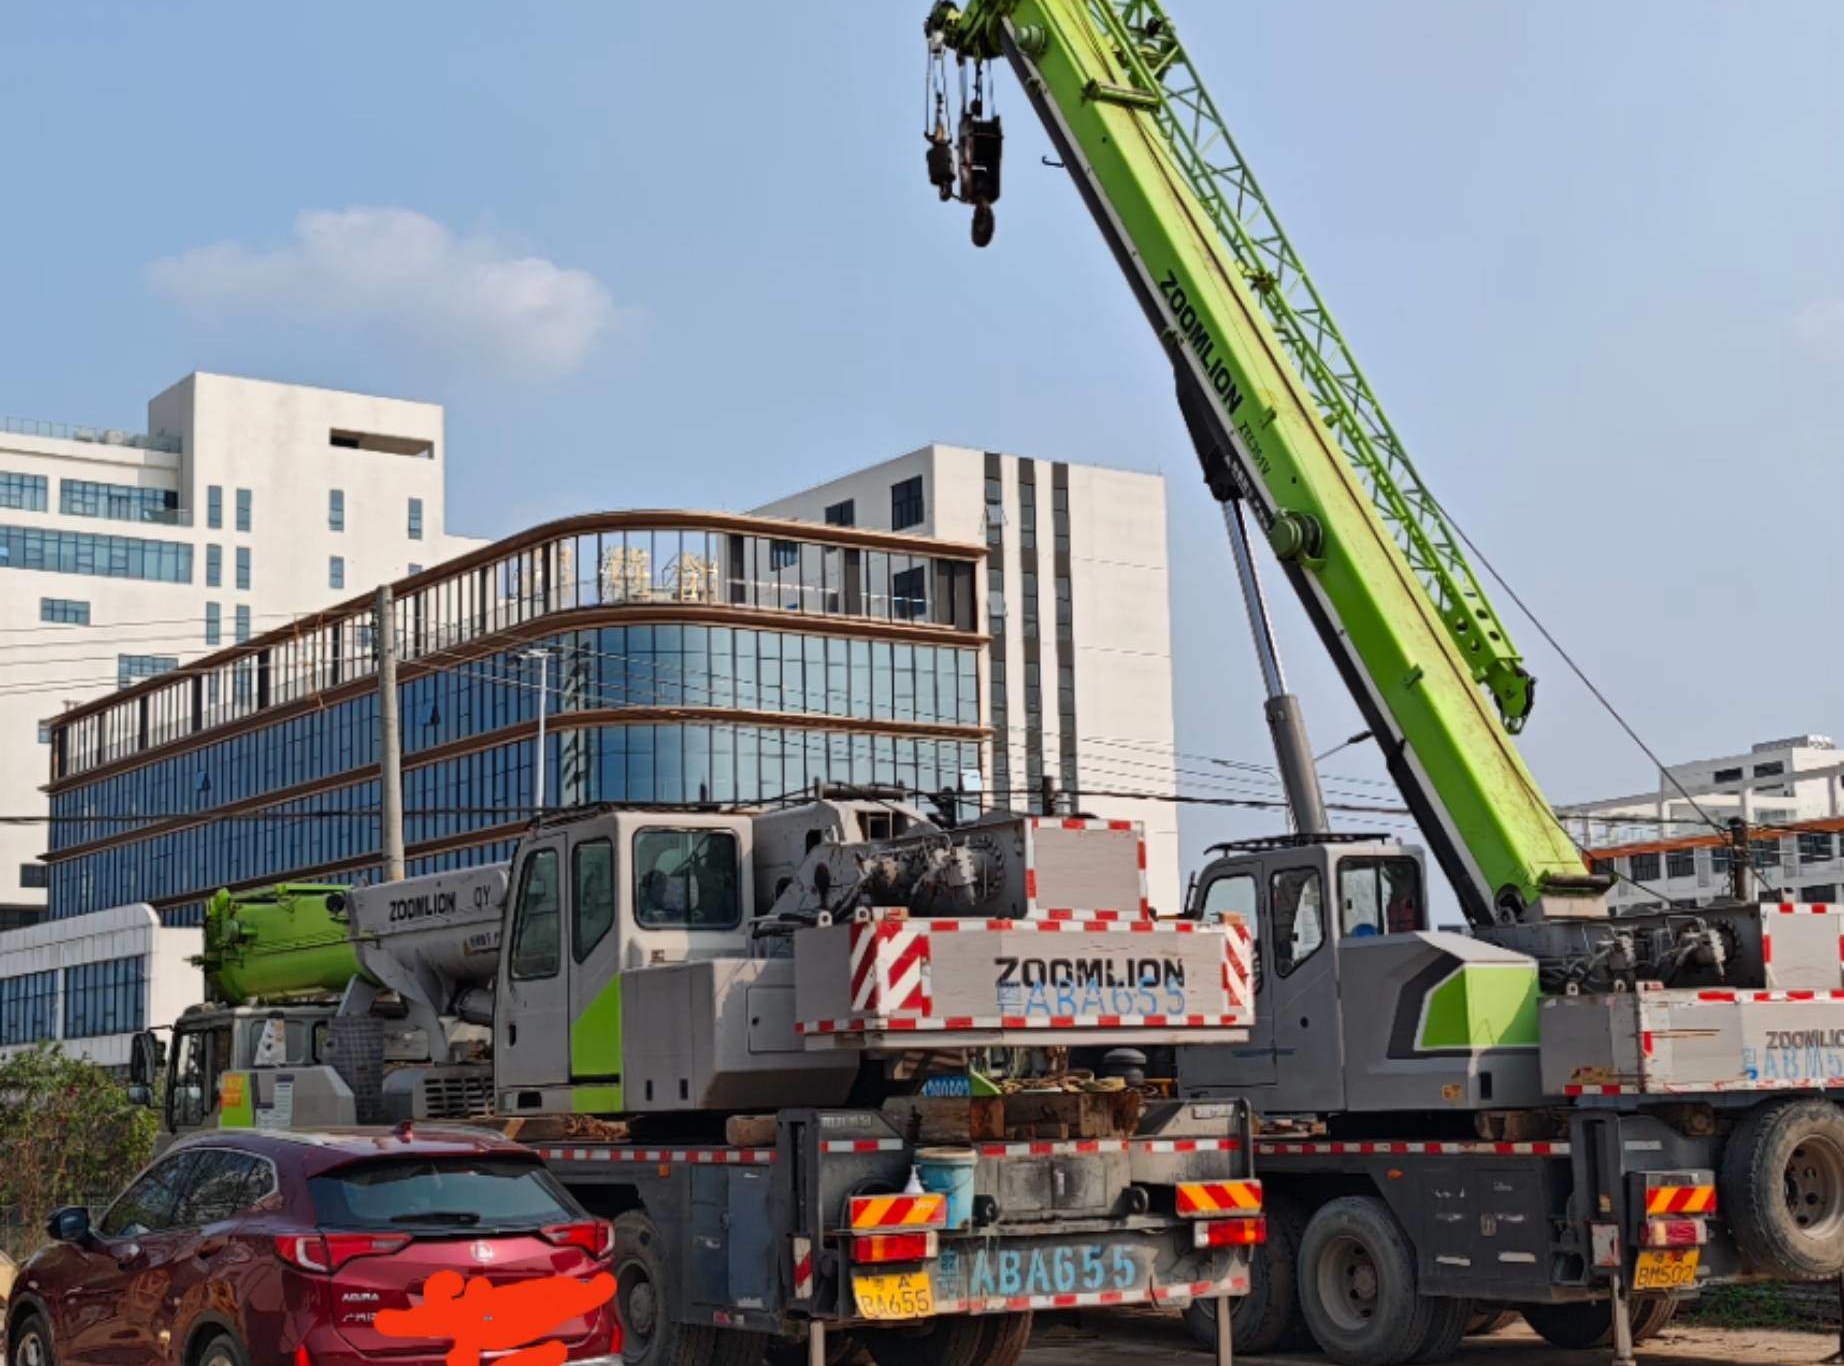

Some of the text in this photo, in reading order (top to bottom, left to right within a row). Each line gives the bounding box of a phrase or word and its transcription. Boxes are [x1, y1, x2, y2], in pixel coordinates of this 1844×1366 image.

[1160, 269, 1244, 415] ZOOMLION
[389, 884, 491, 922] ZOOMLION QY
[994, 957, 1186, 989] ZOOMLION
